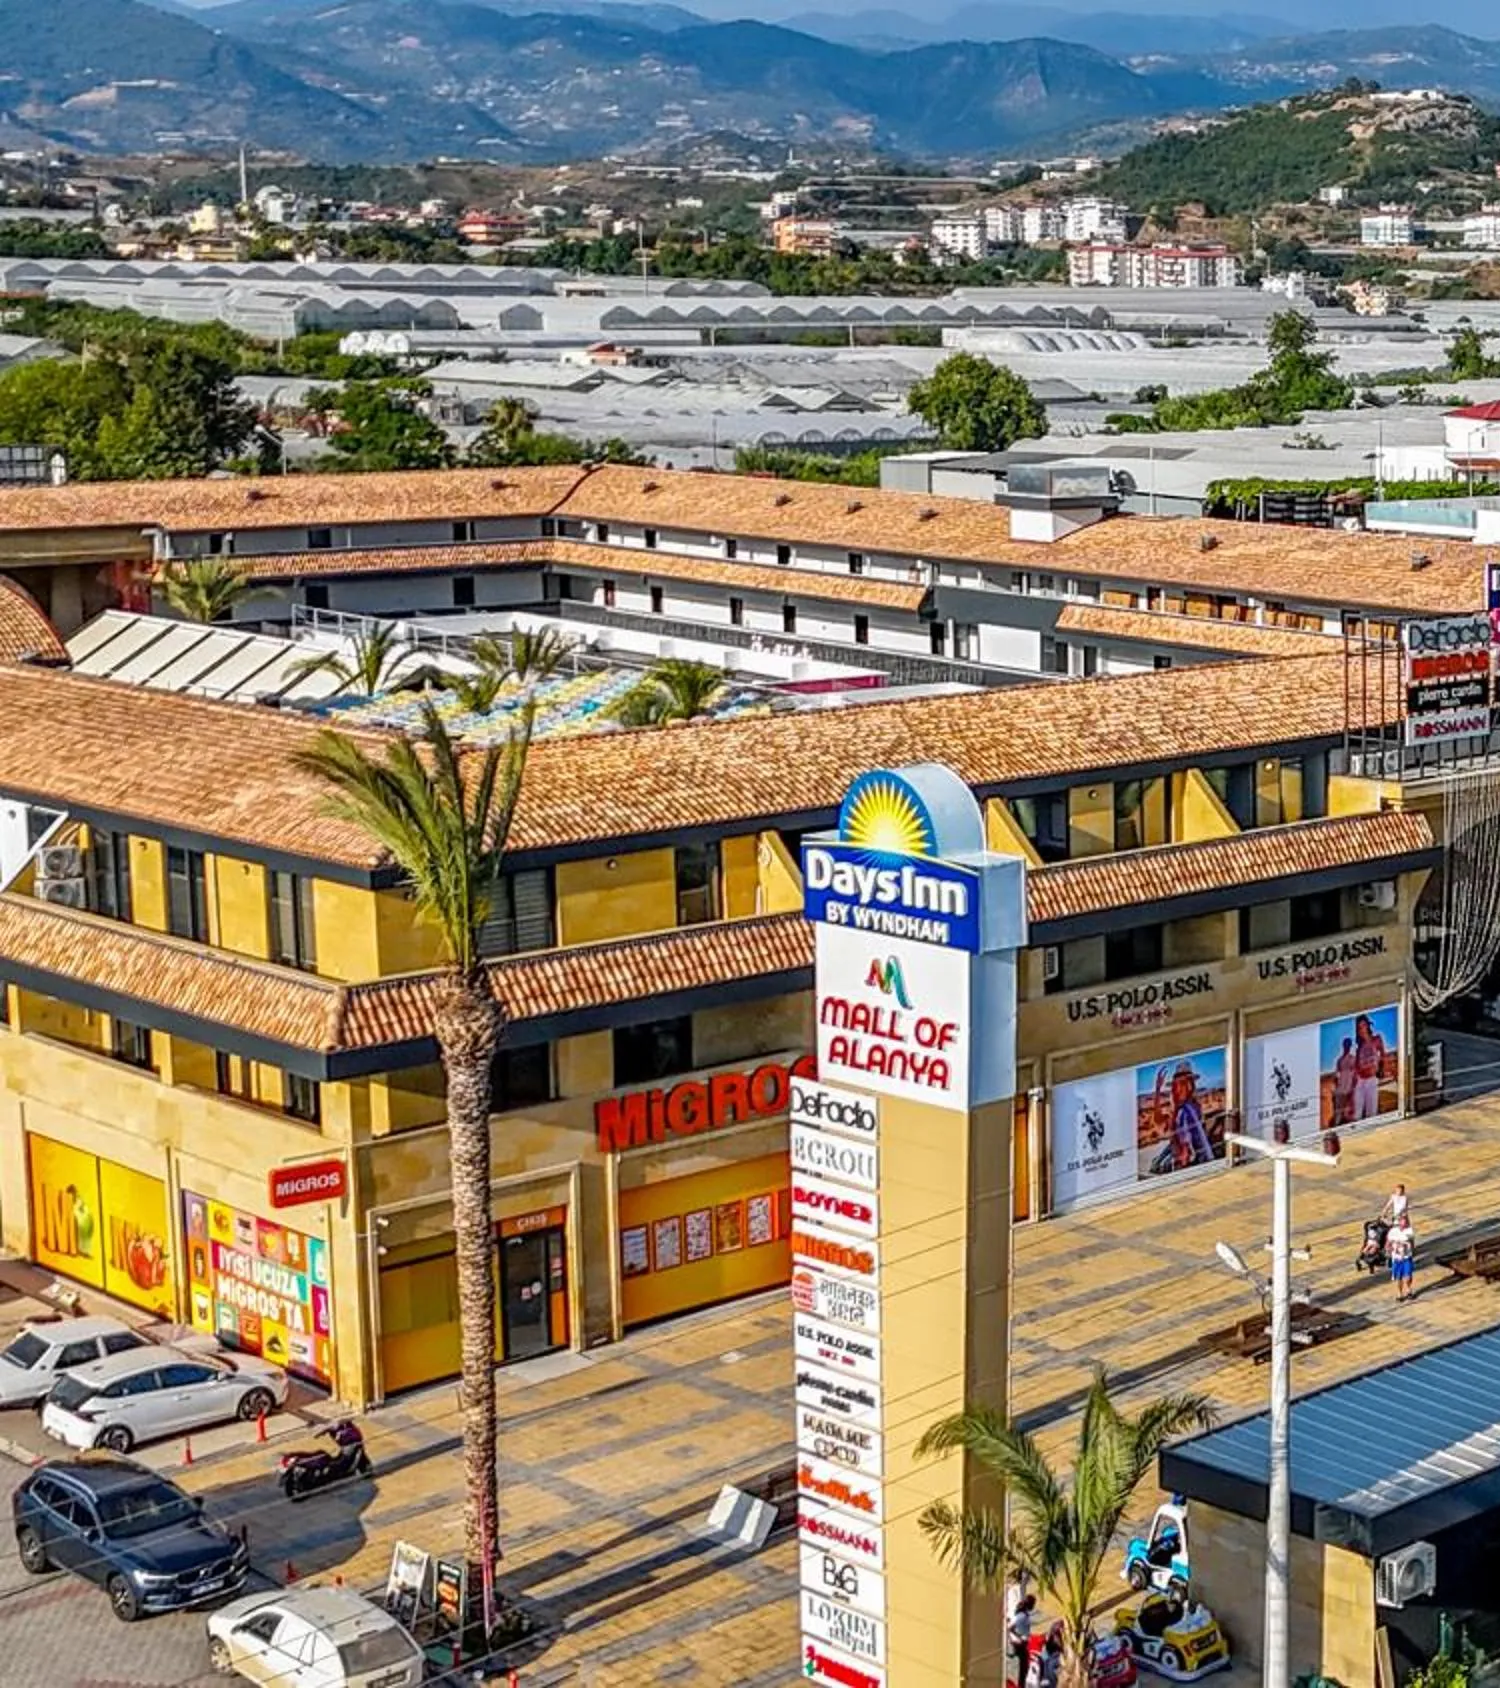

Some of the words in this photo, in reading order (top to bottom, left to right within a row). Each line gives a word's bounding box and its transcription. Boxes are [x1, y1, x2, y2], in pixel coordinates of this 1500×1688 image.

[1409, 618, 1490, 650] DeFacto
[1414, 714, 1487, 738] ROSSMANN
[826, 901, 850, 923] BY
[853, 905, 949, 943] WYNDHAM
[1258, 960, 1287, 980] U.S.
[1292, 948, 1337, 972] POLO
[1340, 937, 1388, 961] ASSN.
[1068, 997, 1101, 1021] U.S.
[1107, 985, 1157, 1013] POLO
[1162, 973, 1214, 1000] ASSN.
[820, 996, 904, 1042] MALL
[914, 1017, 959, 1050] OF
[828, 1035, 949, 1090] ALANYA
[791, 1085, 875, 1132] DeFacto
[252, 1260, 299, 1298] UCUZA
[796, 1513, 878, 1556] ROSSMANN
